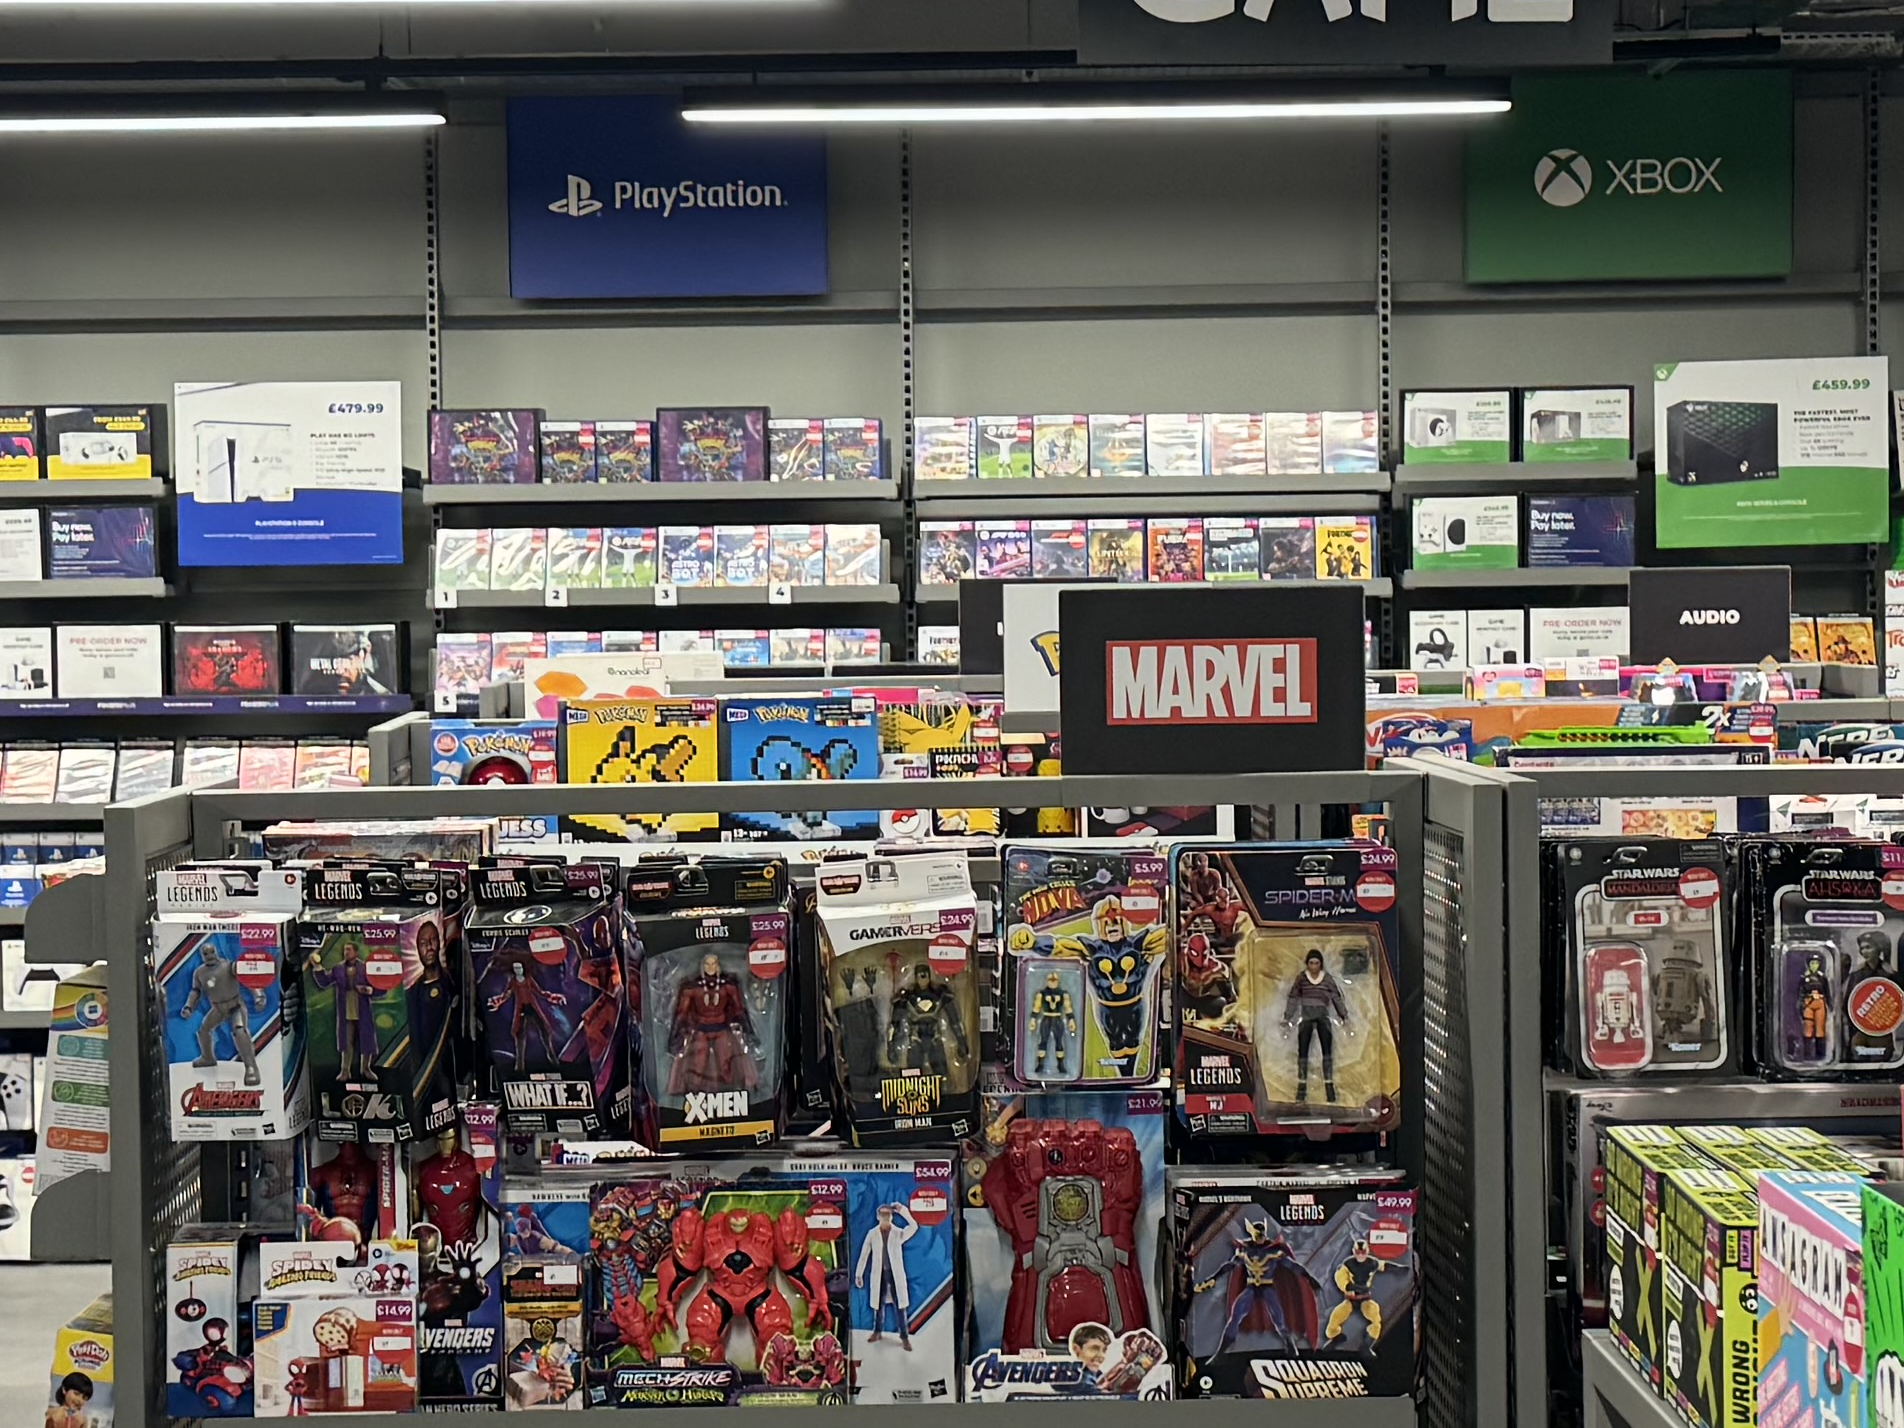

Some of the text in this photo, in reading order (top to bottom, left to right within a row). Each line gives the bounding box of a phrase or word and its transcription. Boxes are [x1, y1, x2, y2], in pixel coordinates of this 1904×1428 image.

[1605, 156, 1724, 196] XBOX
[613, 180, 784, 218] PlayStation
[1812, 379, 1870, 390] £459.99
[328, 403, 384, 413] £479.99
[1531, 510, 1574, 521] Buy now.
[1531, 519, 1575, 532] Pay later.
[1679, 610, 1740, 625] AUDIO
[1112, 644, 1312, 724] MARVEL
[1135, 861, 1163, 874] £5.99
[1612, 868, 1680, 879] STAR WARS
[167, 884, 219, 903] LEGENDS
[315, 883, 363, 900] LEGENDS
[940, 912, 974, 926] £24.99
[240, 928, 275, 940] £22.99
[363, 928, 396, 940] £25.99
[1376, 1196, 1412, 1210] £49.99
[376, 1304, 412, 1318] £14.99
[1732, 1339, 1750, 1426] WRONG
